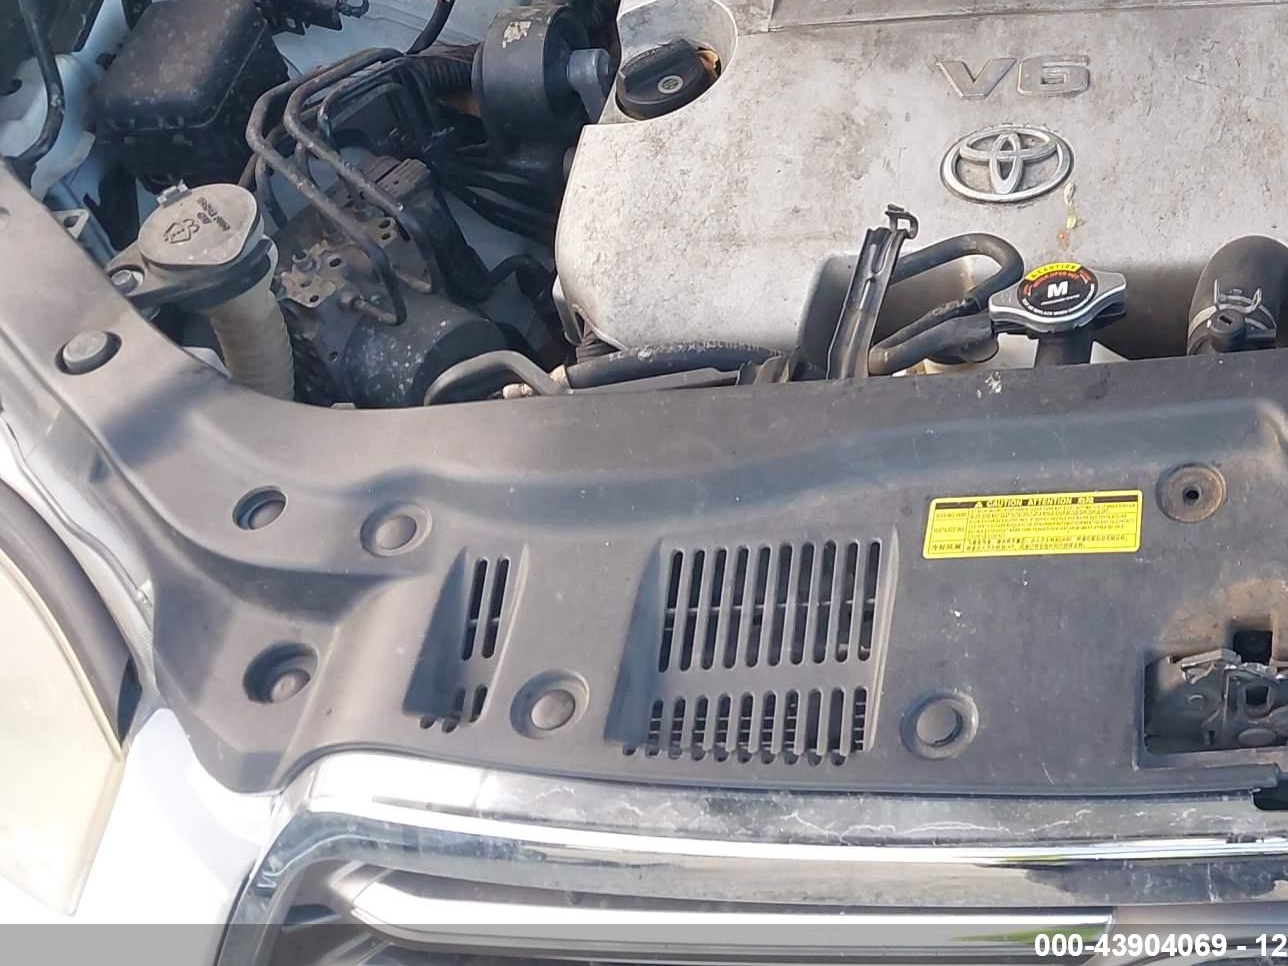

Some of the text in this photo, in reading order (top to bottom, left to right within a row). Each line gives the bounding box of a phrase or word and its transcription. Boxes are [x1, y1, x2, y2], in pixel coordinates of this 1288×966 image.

[935, 55, 1090, 99] V6
[1047, 280, 1069, 299] M
[986, 496, 1072, 508] CAUTION ATTENTION
